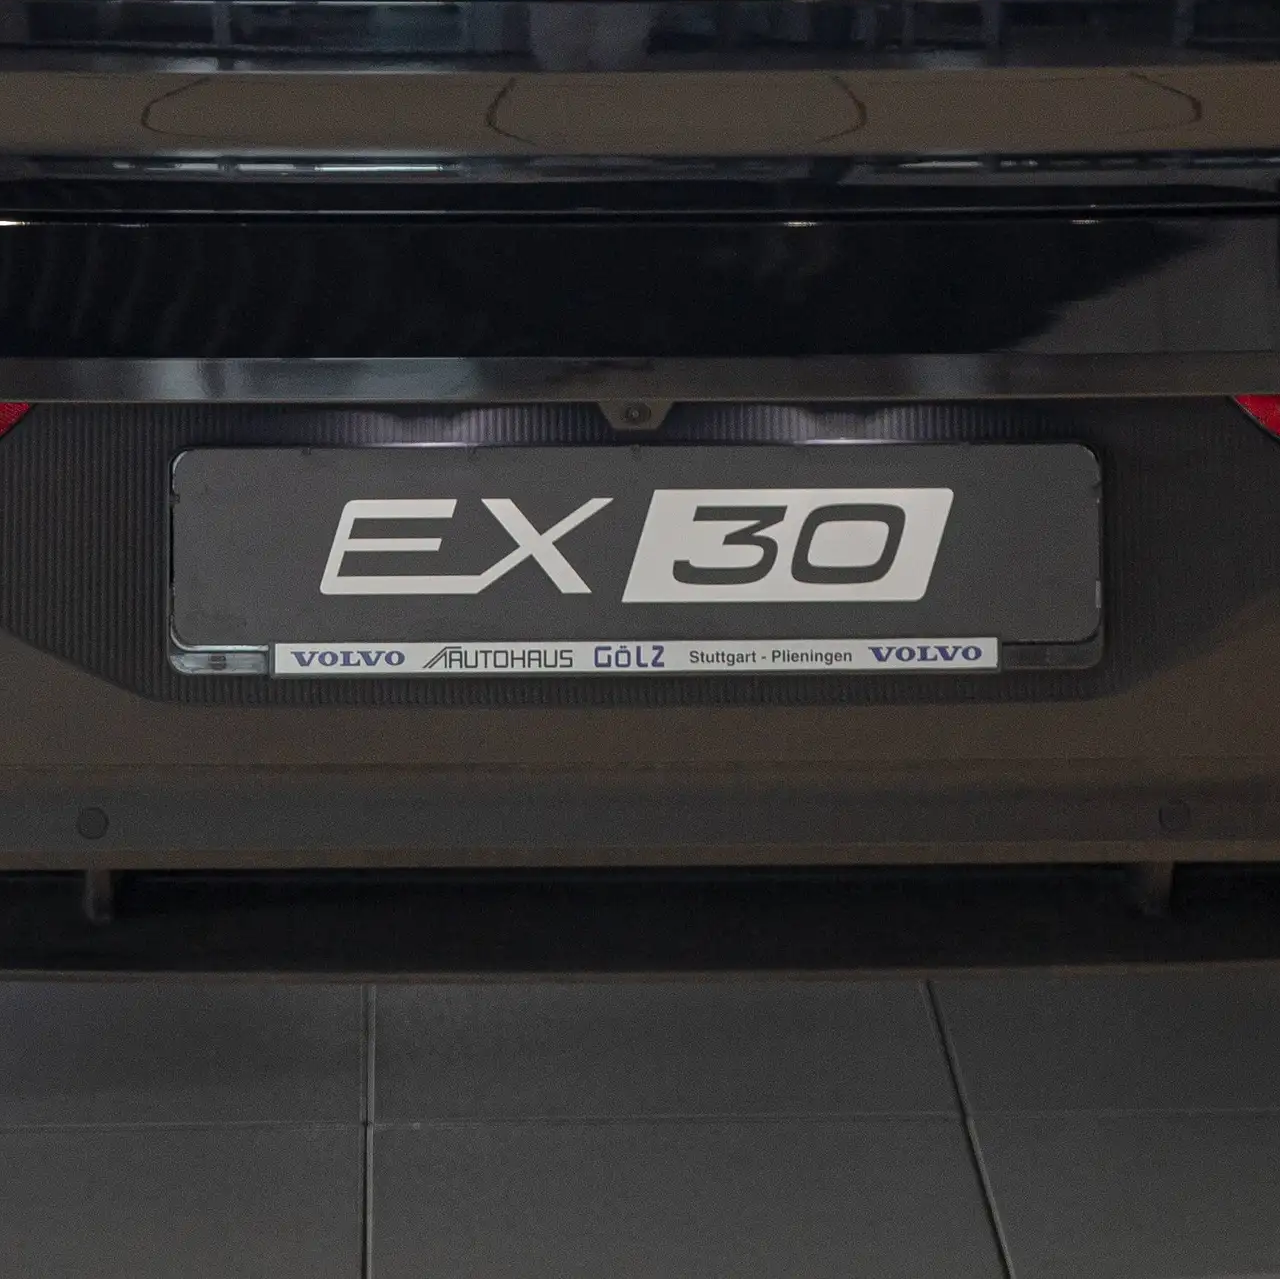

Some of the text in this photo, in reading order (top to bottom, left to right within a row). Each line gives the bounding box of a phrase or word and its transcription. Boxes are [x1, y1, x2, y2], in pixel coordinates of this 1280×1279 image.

[291, 650, 406, 667] VOLVO
[423, 646, 573, 669] AUTOHAUS
[594, 646, 665, 668] GÖLZ
[689, 650, 757, 665] Stuttgart
[771, 648, 853, 665] Plieningen
[868, 646, 983, 662] VOLVO
